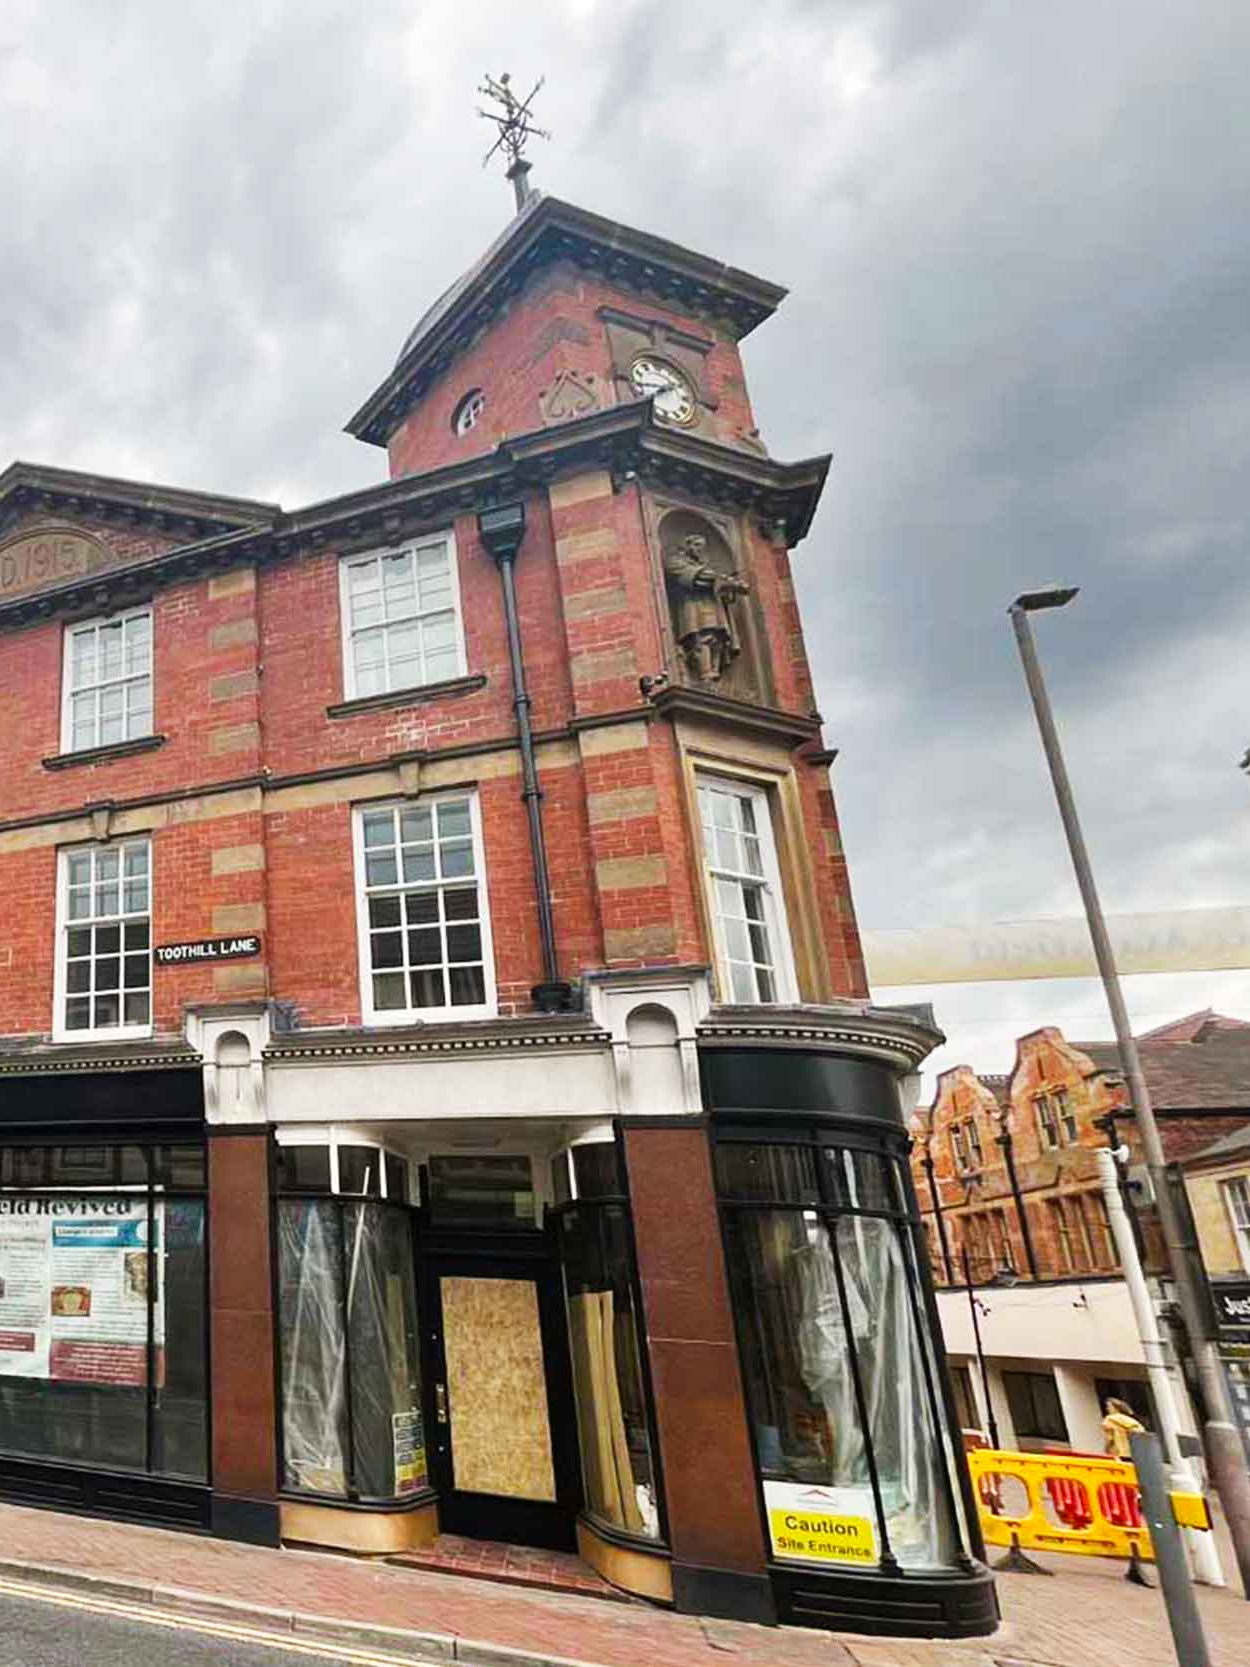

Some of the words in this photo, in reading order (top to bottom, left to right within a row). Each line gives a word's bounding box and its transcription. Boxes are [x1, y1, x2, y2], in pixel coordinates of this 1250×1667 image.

[157, 943, 216, 960] TOOTHILL
[220, 938, 256, 955] LANE
[785, 1515, 858, 1536] Caution
[777, 1536, 805, 1551] Site
[808, 1540, 871, 1557] Entrance
